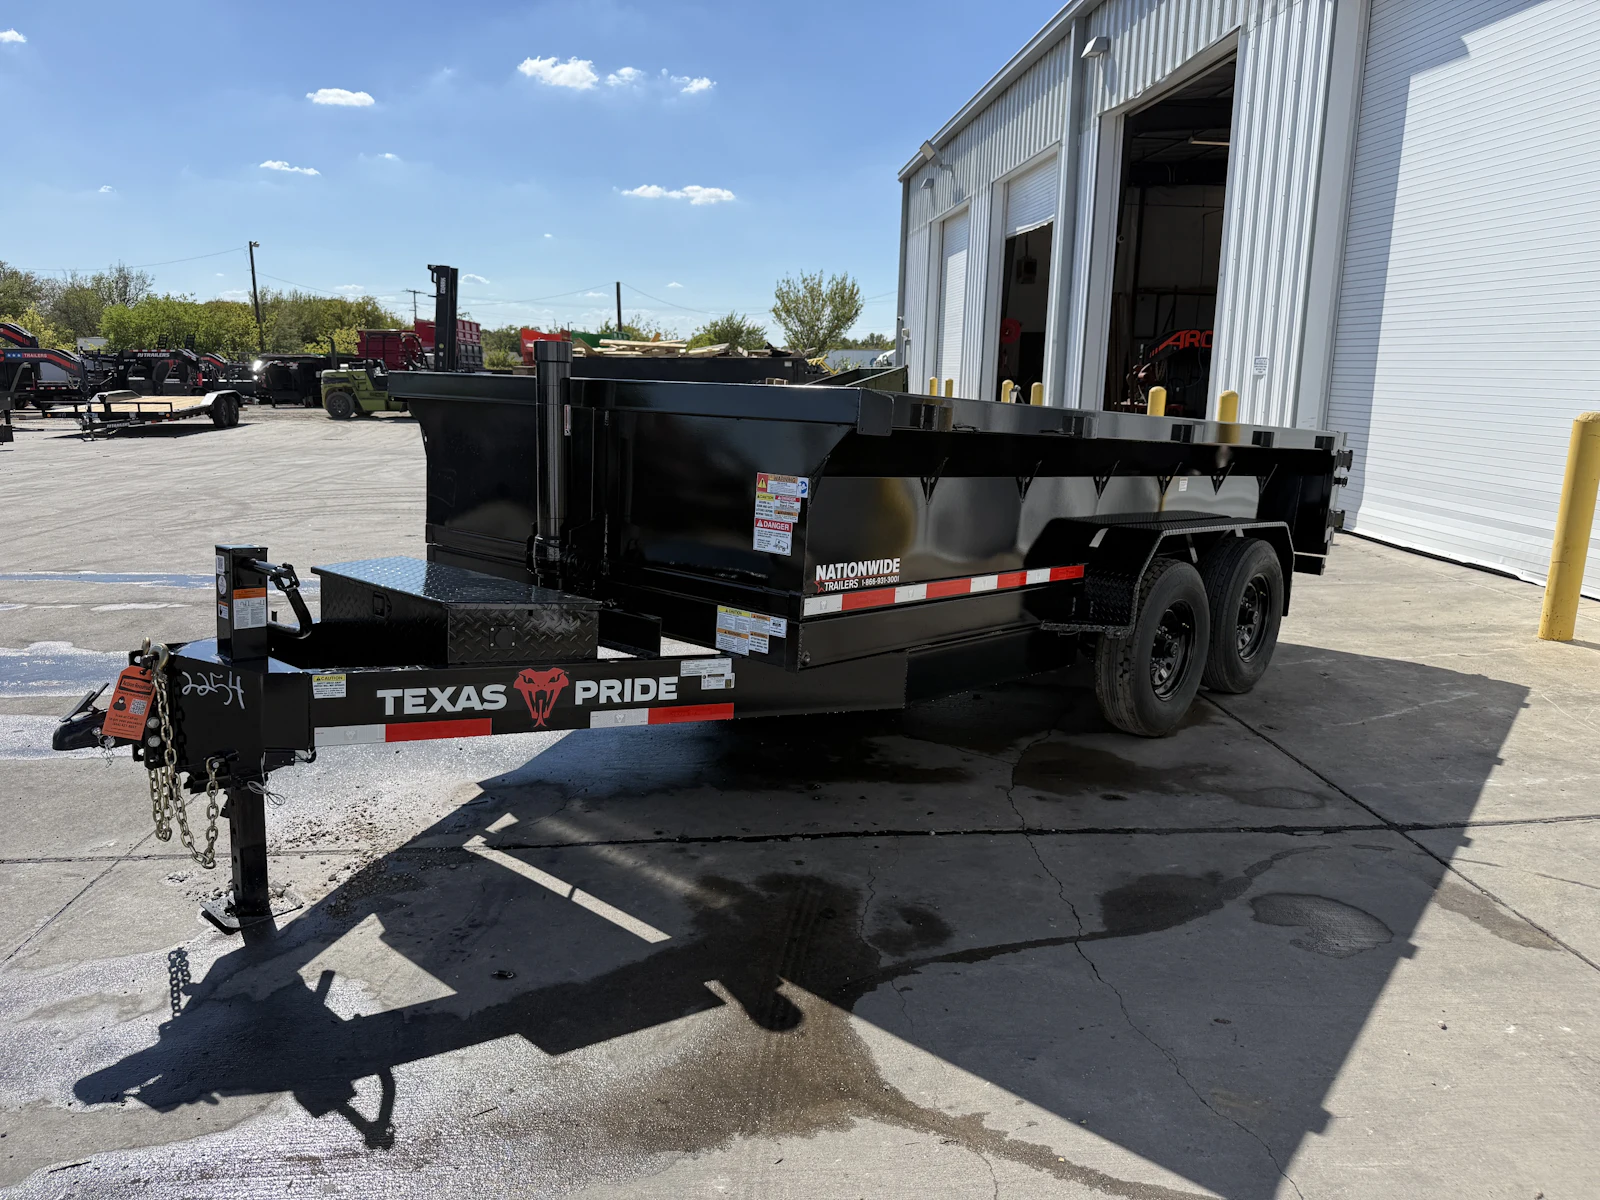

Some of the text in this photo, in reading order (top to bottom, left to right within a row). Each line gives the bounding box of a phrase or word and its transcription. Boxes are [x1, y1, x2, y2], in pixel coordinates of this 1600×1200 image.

[763, 520, 790, 531] DANGER
[815, 558, 901, 580] NATIONWIDE
[824, 575, 900, 591] TRAILERS 1-866-931-3001
[181, 670, 246, 710] 2254
[376, 684, 508, 715] TEXAS
[574, 676, 679, 705] PRIDE
